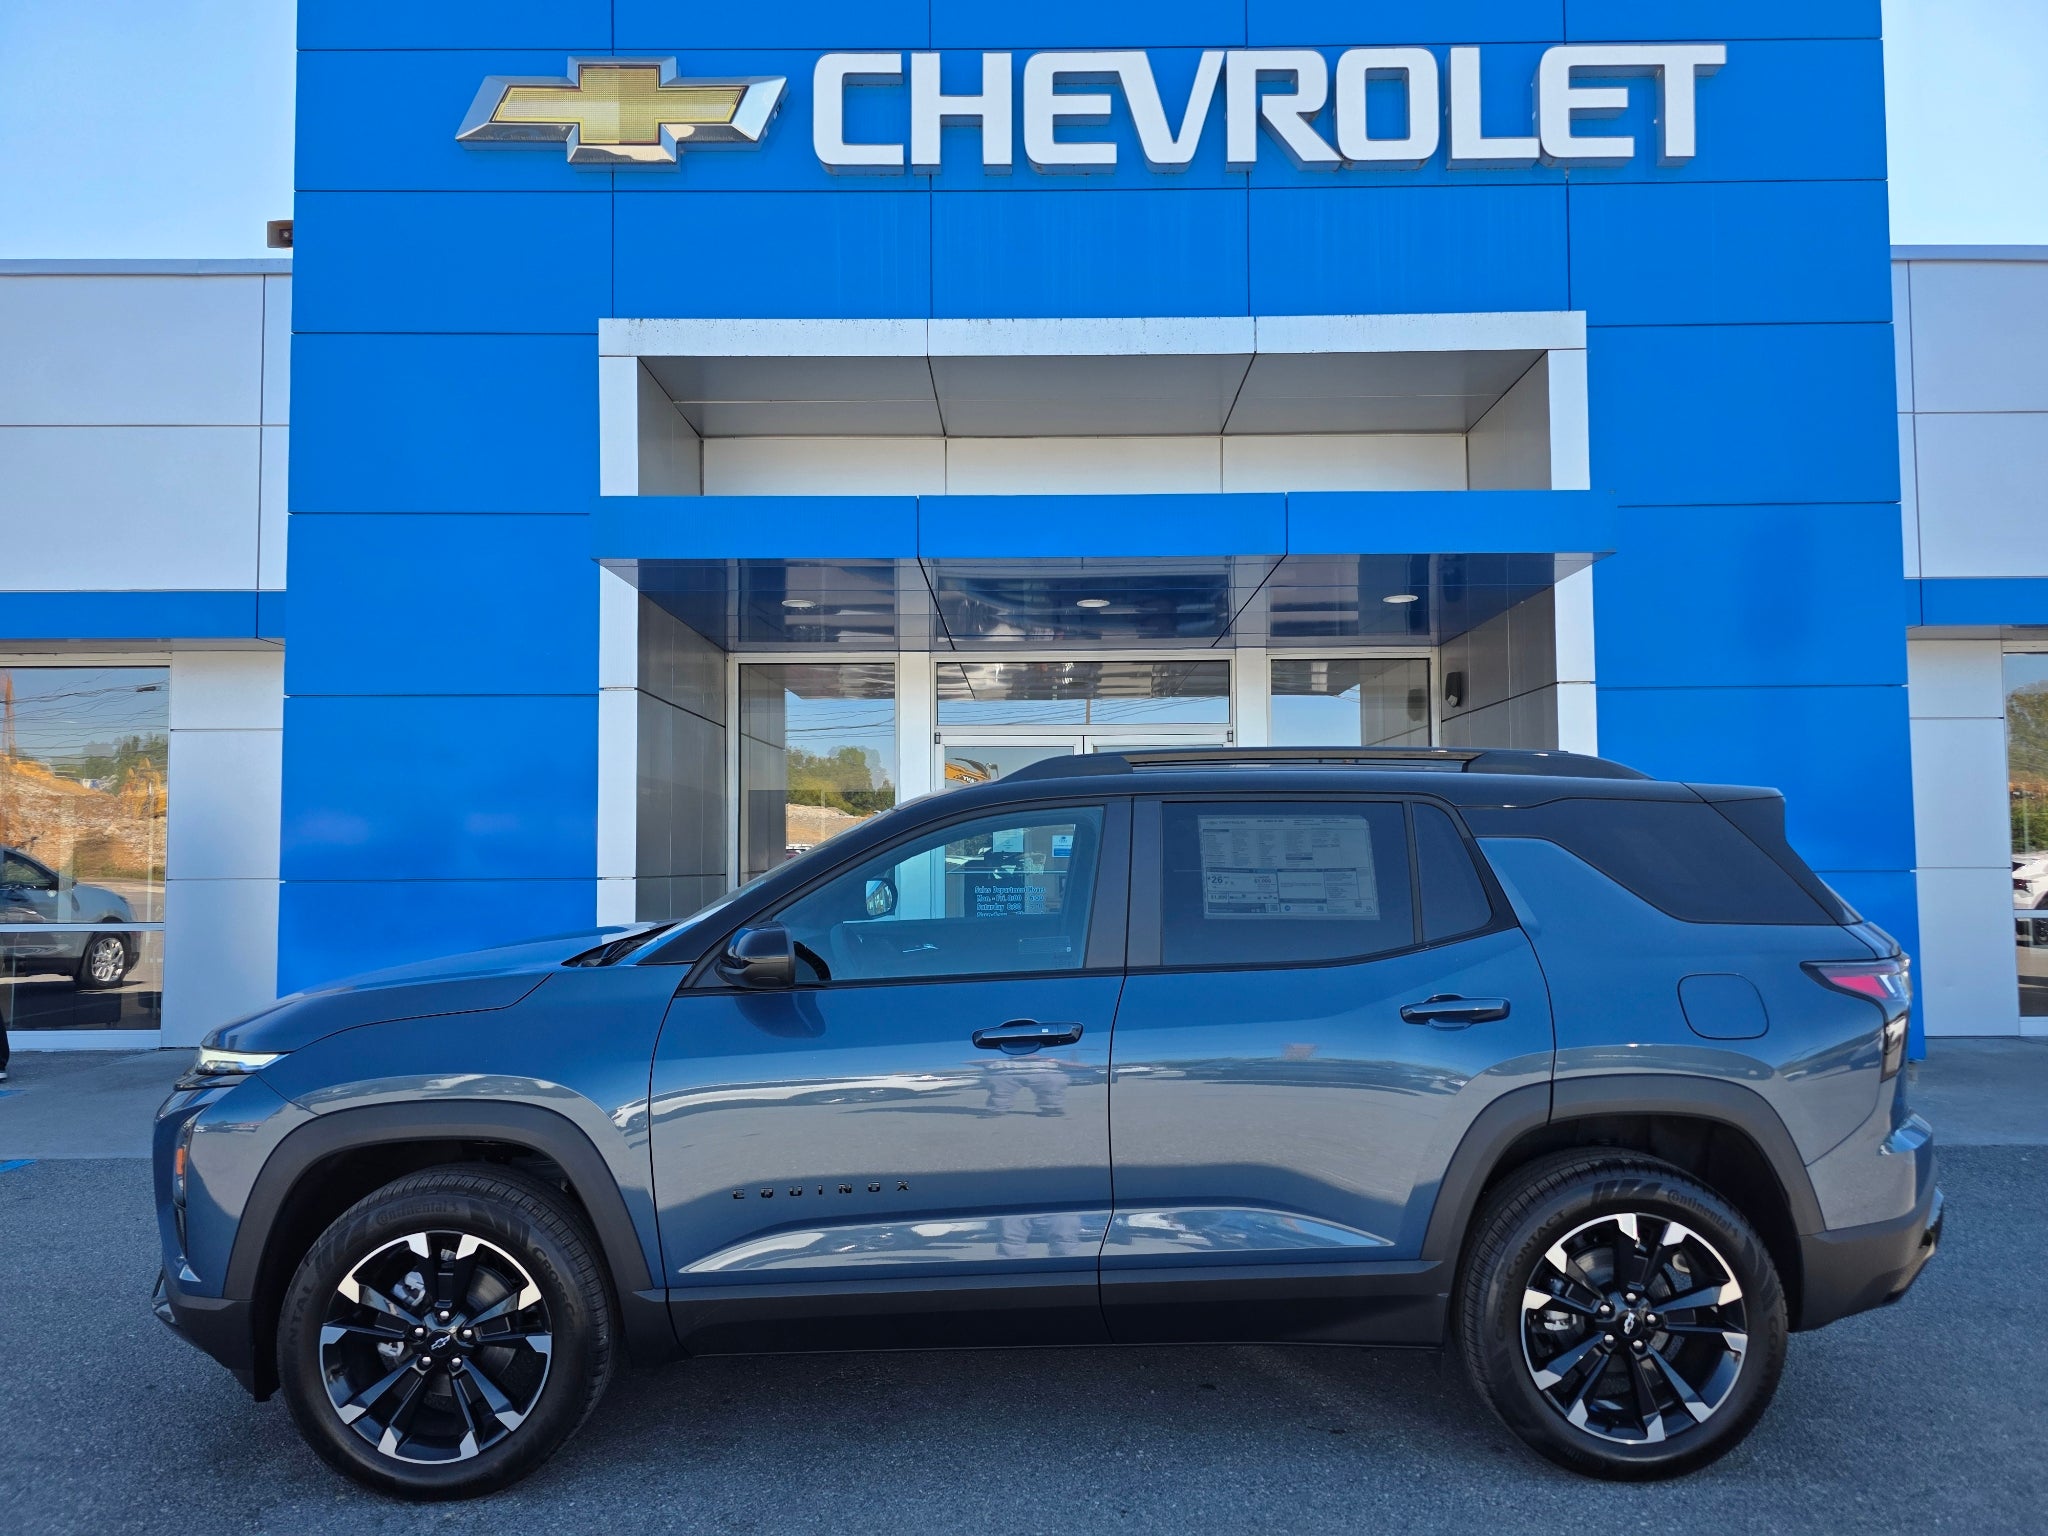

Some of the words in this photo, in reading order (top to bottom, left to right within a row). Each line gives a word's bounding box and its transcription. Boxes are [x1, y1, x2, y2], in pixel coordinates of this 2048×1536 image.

[813, 44, 1727, 168] CHEVROLET
[974, 886, 992, 894] Sales
[992, 886, 1027, 896] Department
[976, 903, 1005, 912] Saturday
[732, 1180, 909, 1200] EQUINOX
[376, 1199, 447, 1225] Continental
[1667, 1188, 1732, 1233] Continental
